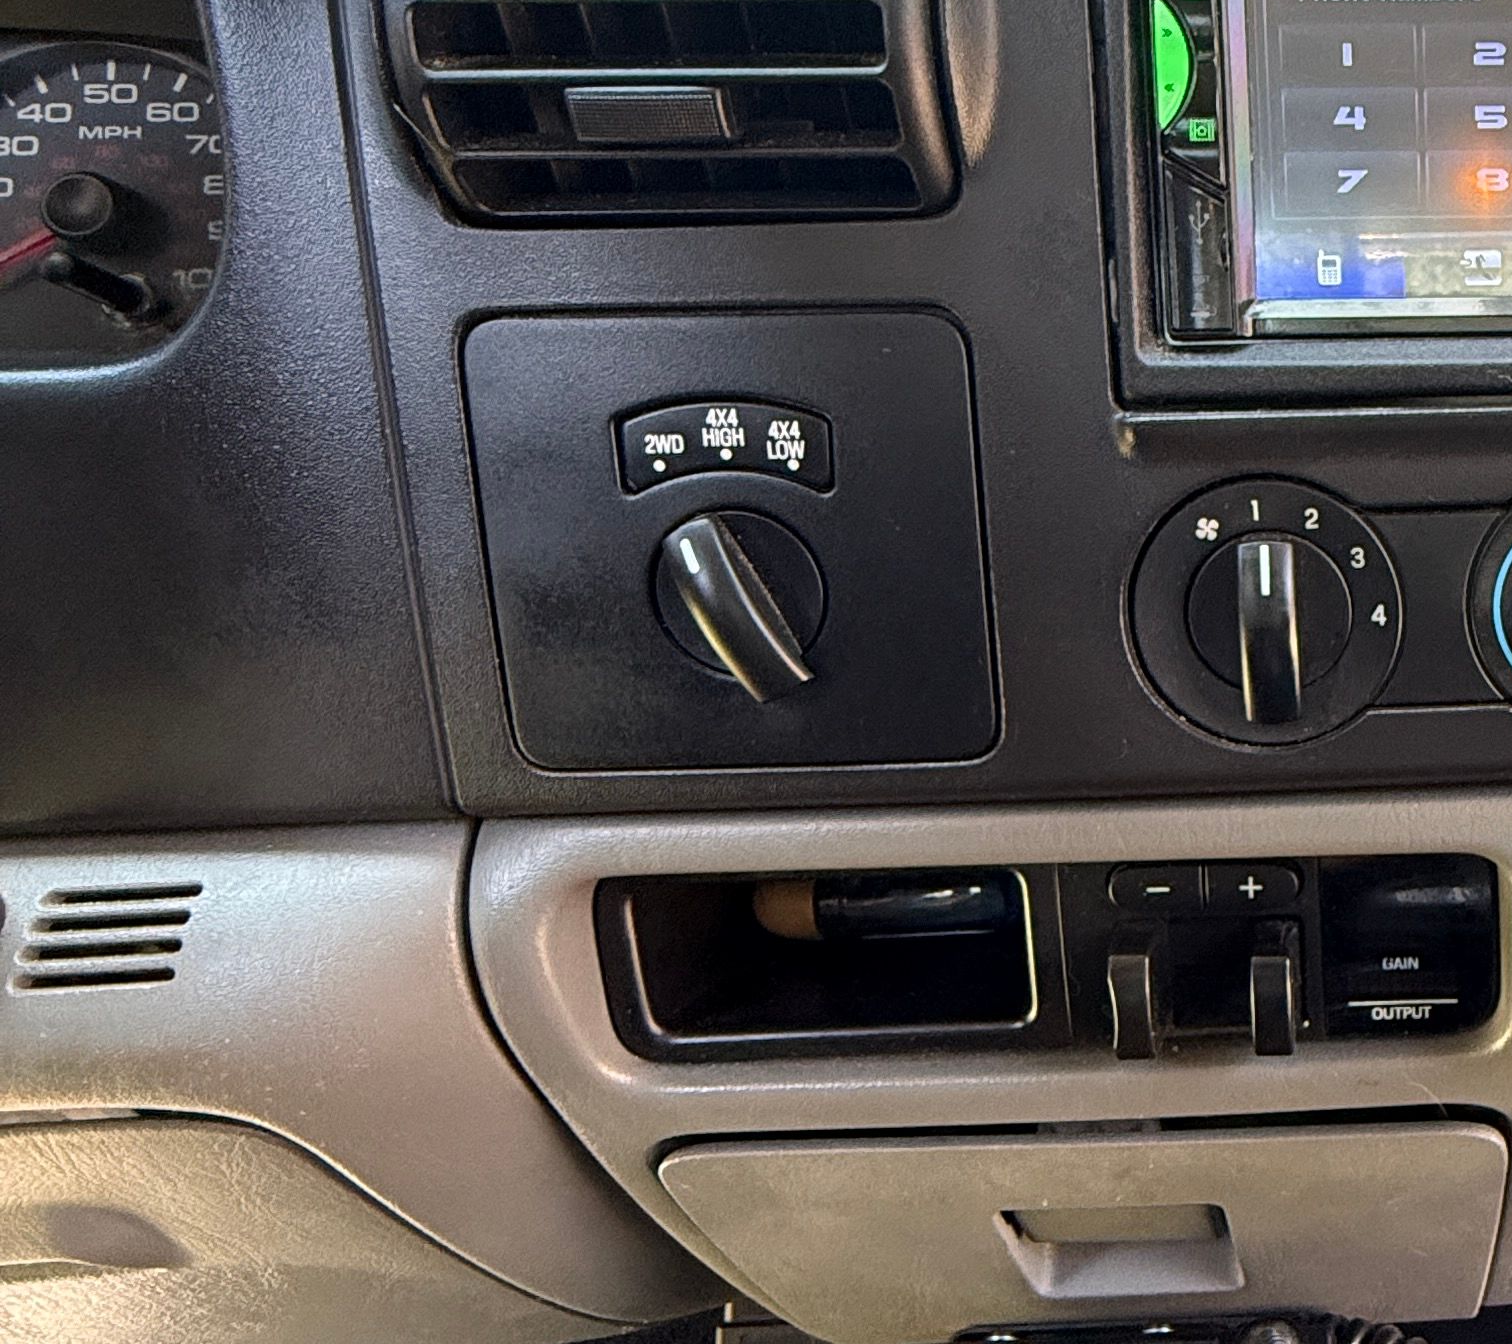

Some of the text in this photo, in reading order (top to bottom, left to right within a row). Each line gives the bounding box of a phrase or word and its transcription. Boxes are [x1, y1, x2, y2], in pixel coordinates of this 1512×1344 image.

[1342, 42, 1352, 67] 1
[1473, 42, 1507, 66] 2
[83, 84, 138, 104] 50
[17, 103, 200, 123] 40 60
[1333, 106, 1366, 130] 4
[1474, 105, 1508, 129] 5
[78, 126, 142, 139] MPH
[1337, 169, 1368, 193] 7
[1476, 167, 1509, 191] 8
[705, 408, 740, 427] 4X4
[701, 428, 745, 447] HIGH
[768, 421, 801, 440] 4X4
[644, 434, 684, 455] 2WD
[766, 440, 805, 460] LOW
[1251, 499, 1260, 522] 1
[1304, 508, 1320, 530] 2
[1350, 547, 1366, 569] 3
[1370, 604, 1388, 626] 4
[1382, 956, 1420, 971] GAIN
[1371, 1005, 1432, 1020] OUTPUT
